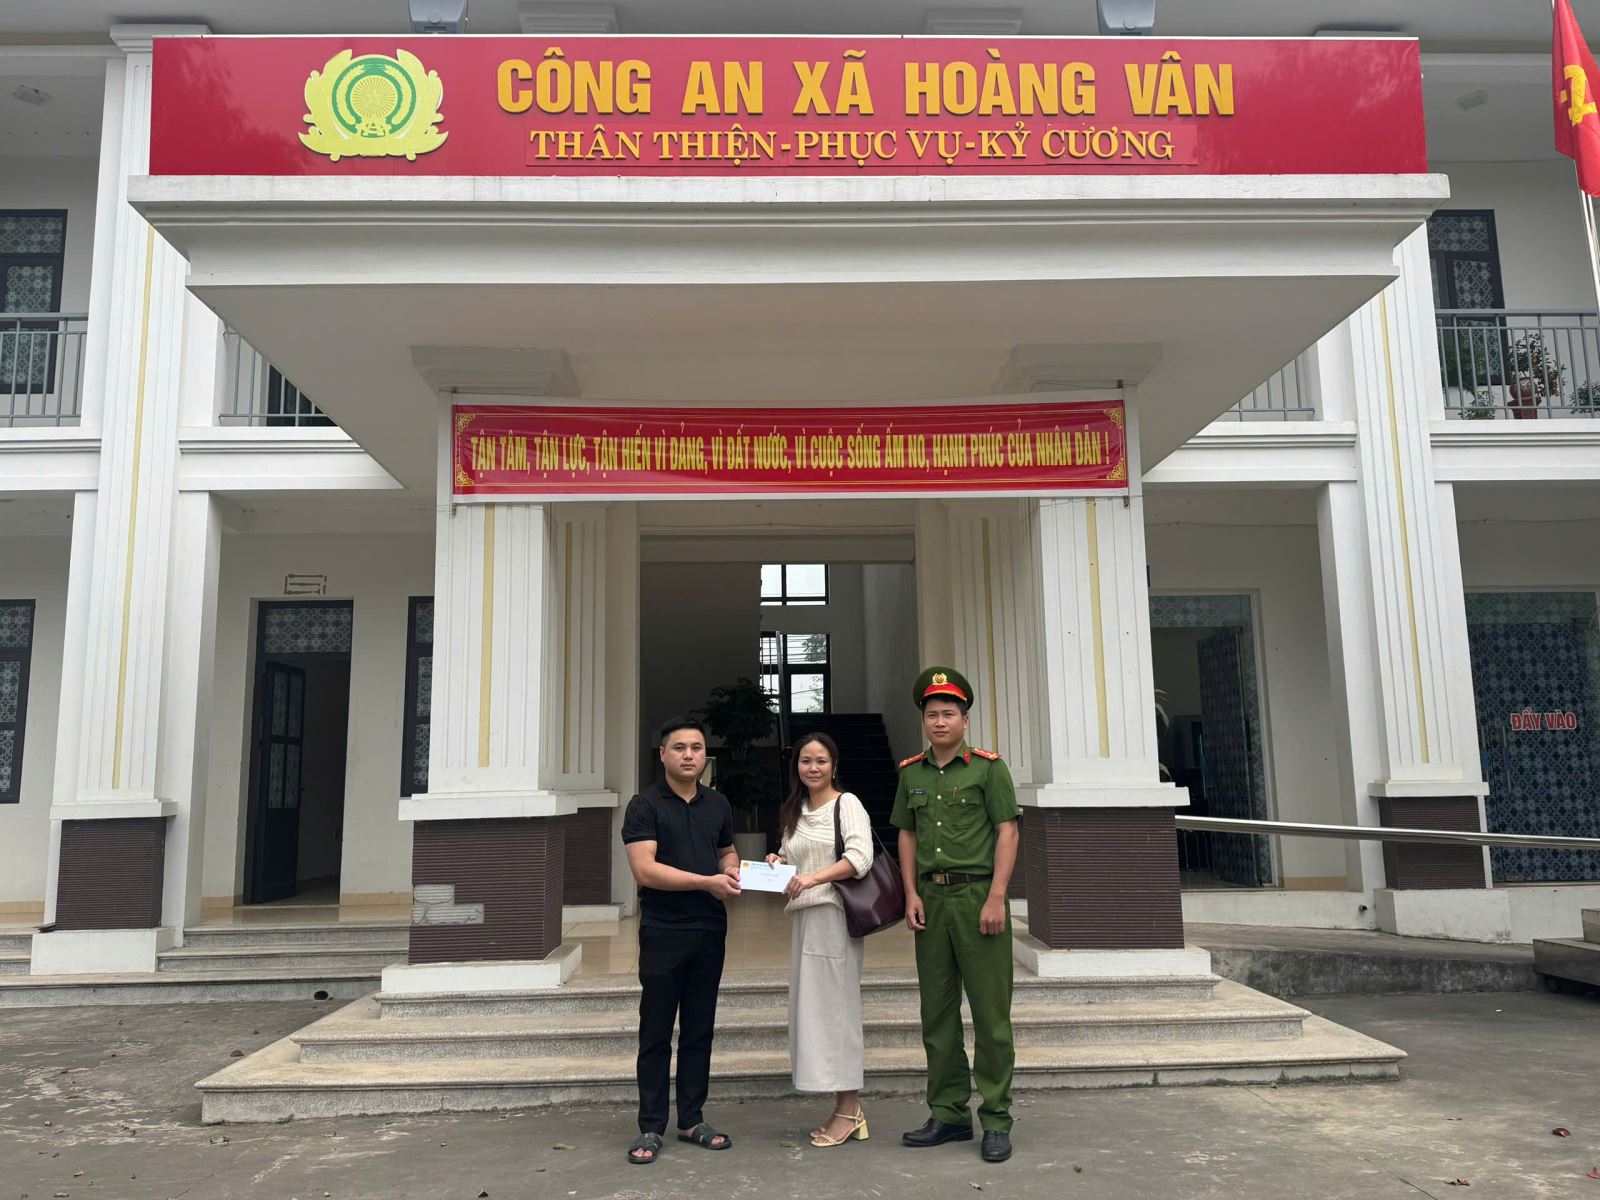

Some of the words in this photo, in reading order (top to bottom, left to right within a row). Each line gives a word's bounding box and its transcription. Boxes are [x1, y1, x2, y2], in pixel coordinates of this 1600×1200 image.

[497, 46, 651, 114] CÔNG
[681, 60, 763, 115] AN
[792, 49, 874, 115] XÃ
[905, 48, 1096, 116] HOÀNG
[1124, 50, 1234, 116] VÂN
[530, 123, 643, 160] THÂN
[1041, 126, 1175, 161] CƯƠNG
[470, 428, 496, 479] TẬN
[500, 428, 531, 474] TÂM,
[534, 429, 559, 479] TẬN
[562, 432, 590, 478] LỰC,
[593, 429, 618, 479] TẬN
[622, 423, 651, 471] HIẾN
[655, 427, 666, 471] VÌ
[711, 427, 724, 471] VÌ
[753, 424, 791, 473] NƯỚC,
[795, 427, 807, 469] VÌ
[810, 427, 843, 477] CUỘC
[847, 422, 881, 469] SỐNG
[884, 422, 904, 469] ẤM
[908, 433, 930, 473] NO,
[933, 432, 967, 476] HẠNH
[970, 425, 1004, 468] PHÚC
[1007, 417, 1033, 467] CỦA
[1036, 424, 1072, 466] NHÂN
[1074, 423, 1101, 466] DÂN
[1544, 708, 1577, 730] VÀO
